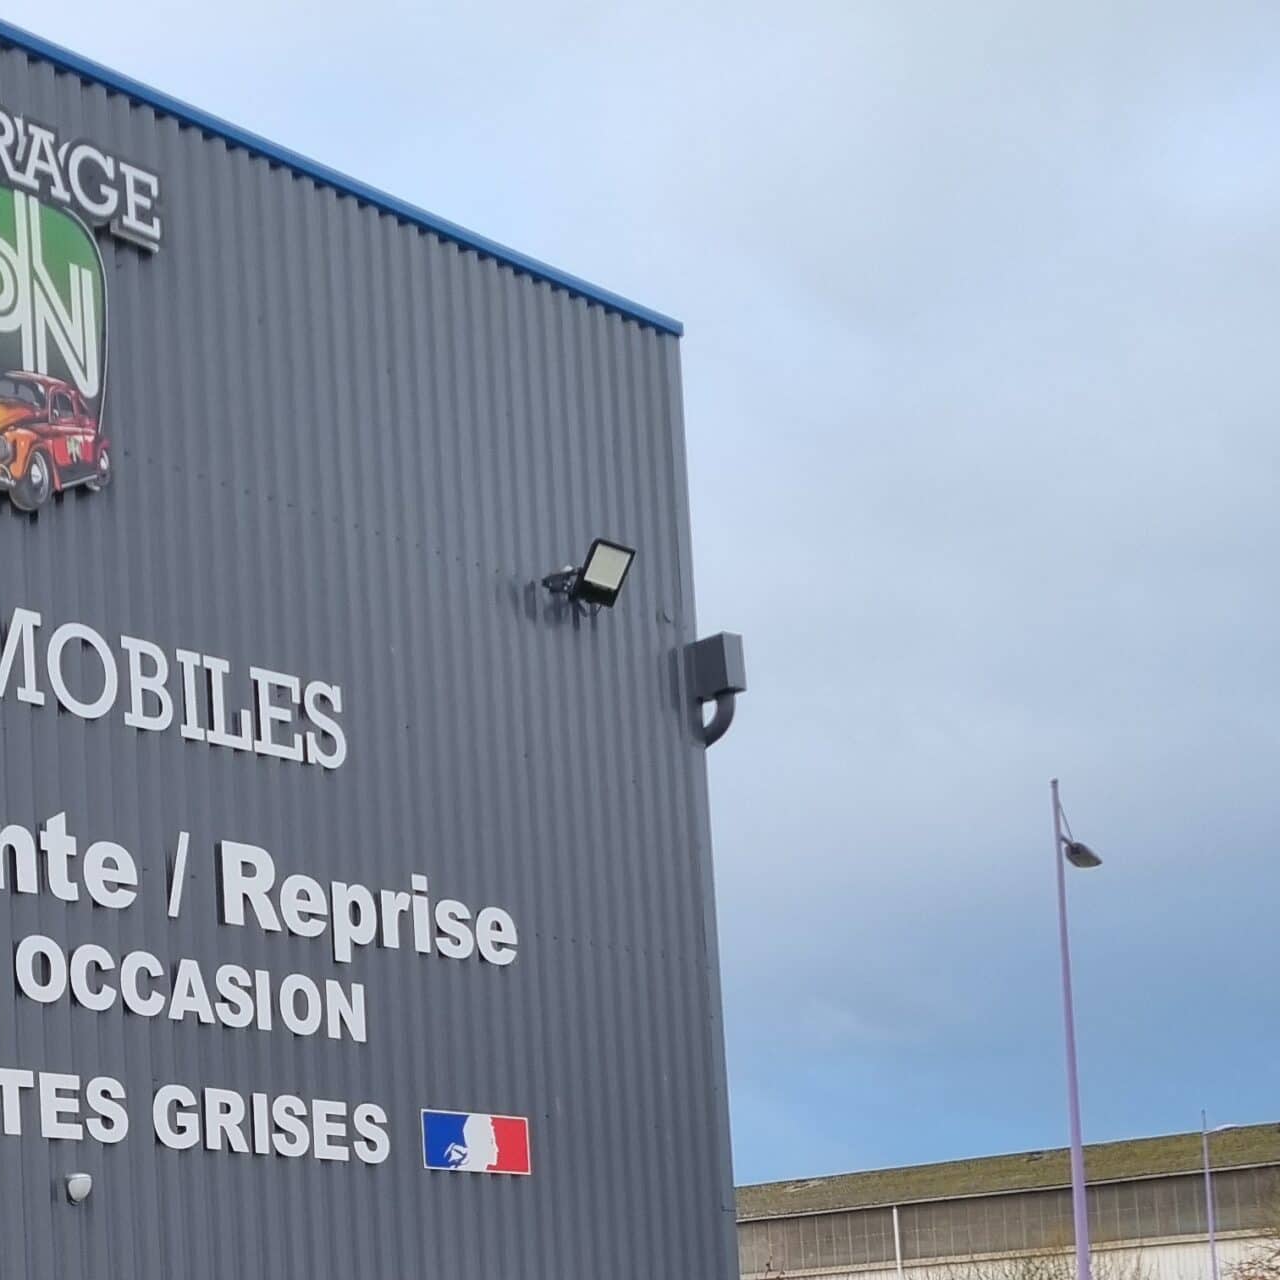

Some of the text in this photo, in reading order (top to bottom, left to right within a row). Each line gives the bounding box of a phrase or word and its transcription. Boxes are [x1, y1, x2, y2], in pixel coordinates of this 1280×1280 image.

[221, 839, 519, 966] Reprise
[15, 934, 368, 1043] OCCASION
[152, 1083, 391, 1165] GRISES
